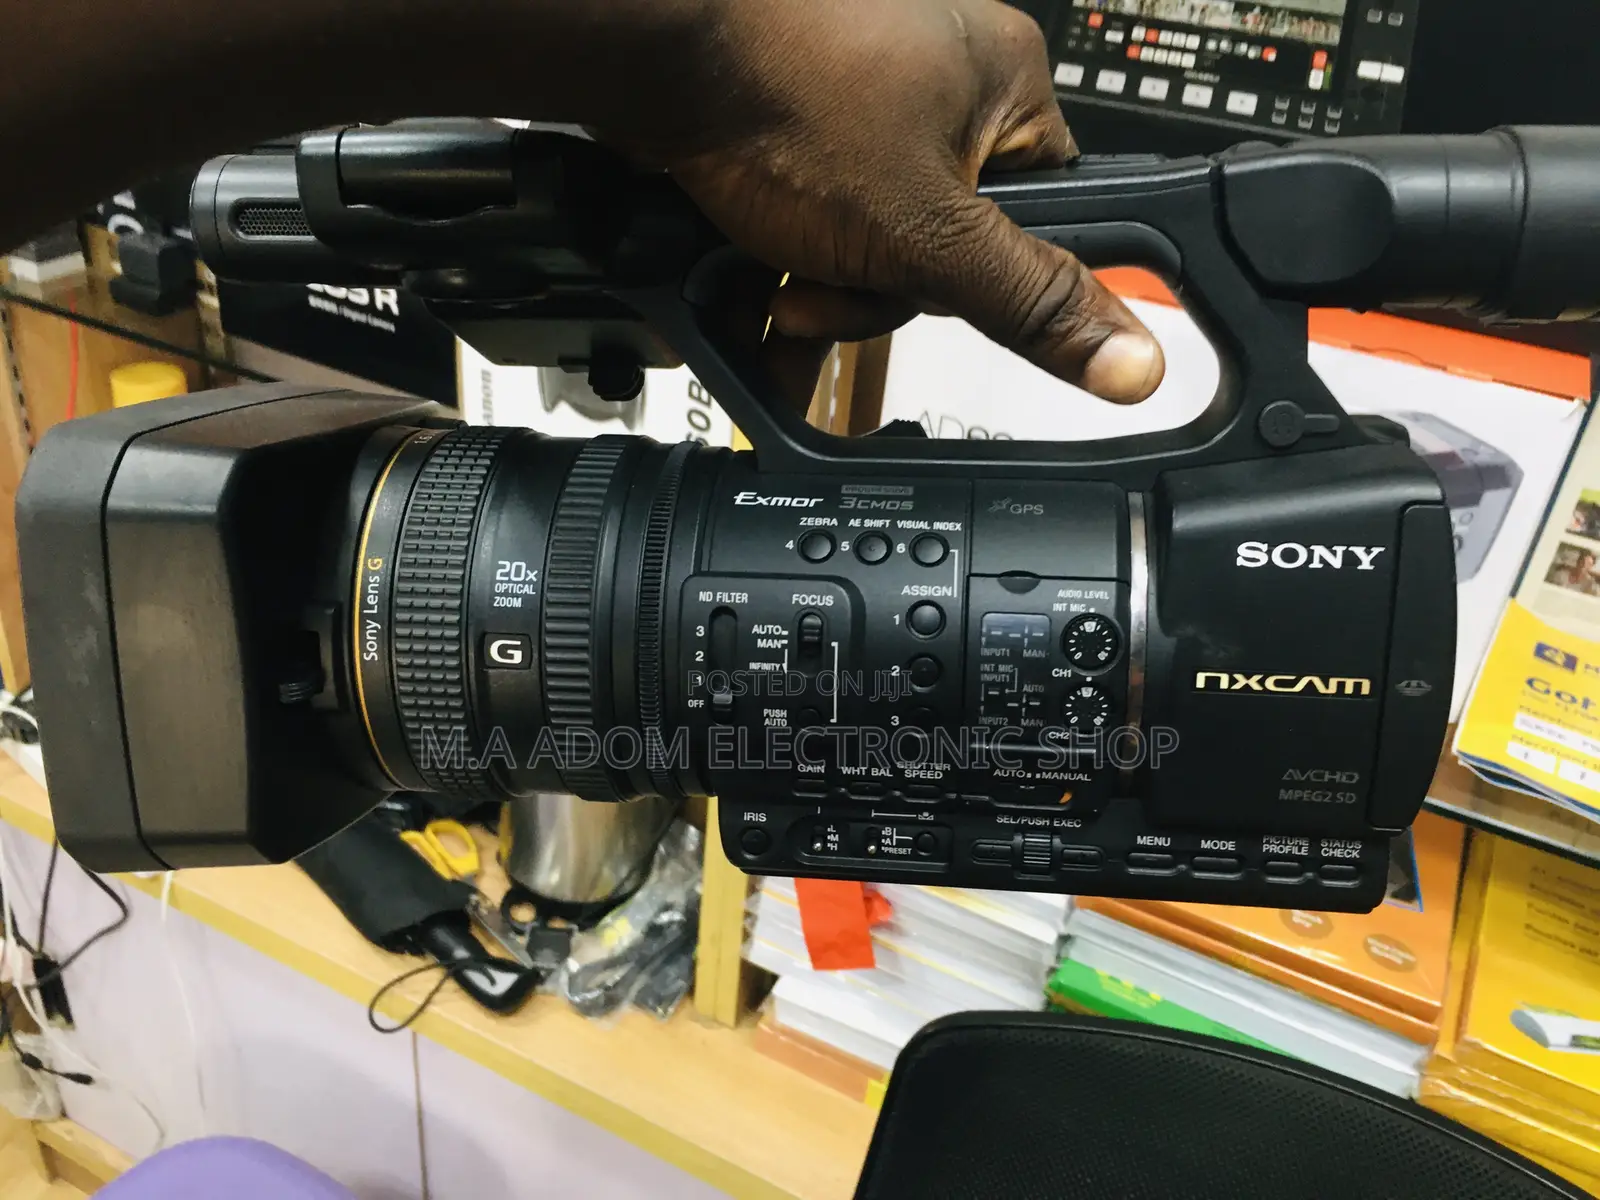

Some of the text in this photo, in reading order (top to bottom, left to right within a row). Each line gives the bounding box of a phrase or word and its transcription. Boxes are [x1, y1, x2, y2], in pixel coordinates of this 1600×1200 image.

[733, 491, 824, 508] Exmor
[838, 497, 914, 510] 3CMOS
[1009, 504, 1044, 515] GPS
[799, 517, 838, 527] ZEBRA
[848, 518, 891, 528] AE SHIFT
[896, 520, 962, 531] VISUAL INDEX
[785, 540, 794, 550] 4
[841, 542, 850, 551] 5
[896, 543, 906, 553] 6
[1236, 541, 1386, 570] SONY
[495, 560, 538, 582] 20x
[494, 583, 536, 595] OPTICAL
[901, 585, 952, 597] ASSIGN
[699, 591, 748, 604] ND FILTER
[1057, 589, 1109, 600] AUDIO LEVEL
[493, 597, 522, 608] ZOOM
[792, 594, 834, 606] FOCUS
[363, 557, 383, 661] Sony Lens G
[1053, 603, 1087, 612] INT MIC
[893, 614, 900, 625] 1
[696, 626, 705, 637] 3
[752, 624, 782, 635] AUTO
[757, 639, 782, 648] MAN
[489, 639, 523, 664] G
[695, 651, 704, 661] 2
[981, 648, 1010, 657] INPUT1
[1023, 649, 1045, 658] MAN
[749, 662, 781, 671] INFINITY
[891, 666, 900, 676] 2
[998, 664, 1014, 673] MIC
[1052, 668, 1072, 677] CH1
[696, 676, 702, 686] 1
[981, 674, 1010, 682] INPUT1
[1023, 684, 1044, 692] AUTO
[688, 699, 704, 708] OFF
[763, 709, 787, 718] PUSH
[764, 718, 787, 727] AUTO
[890, 716, 900, 726] 3
[978, 717, 1008, 726] INPUT2
[1021, 719, 1043, 727] MAN
[1049, 731, 1070, 740] CH2
[797, 764, 825, 774] GAIN
[896, 761, 951, 771] SHUTTER
[841, 766, 893, 777] WHT BAL
[904, 769, 943, 780] SPEED
[993, 769, 1025, 779] AUTO
[1041, 771, 1092, 782] MANUAL
[1282, 768, 1359, 784] AVCHD
[1278, 788, 1356, 804] MPEG2 SD
[743, 812, 767, 822] IRIS
[996, 815, 1081, 828] SEL/PUSH EXEC
[885, 827, 892, 836] B
[884, 837, 892, 845] A
[1137, 835, 1170, 847] MENU
[1200, 839, 1236, 851] MODE
[1262, 835, 1309, 846] PICTURE
[1320, 838, 1362, 849] STATUS
[884, 847, 912, 855] PRESET
[1262, 844, 1309, 856] PROFILE
[1321, 847, 1360, 858] CHECK
